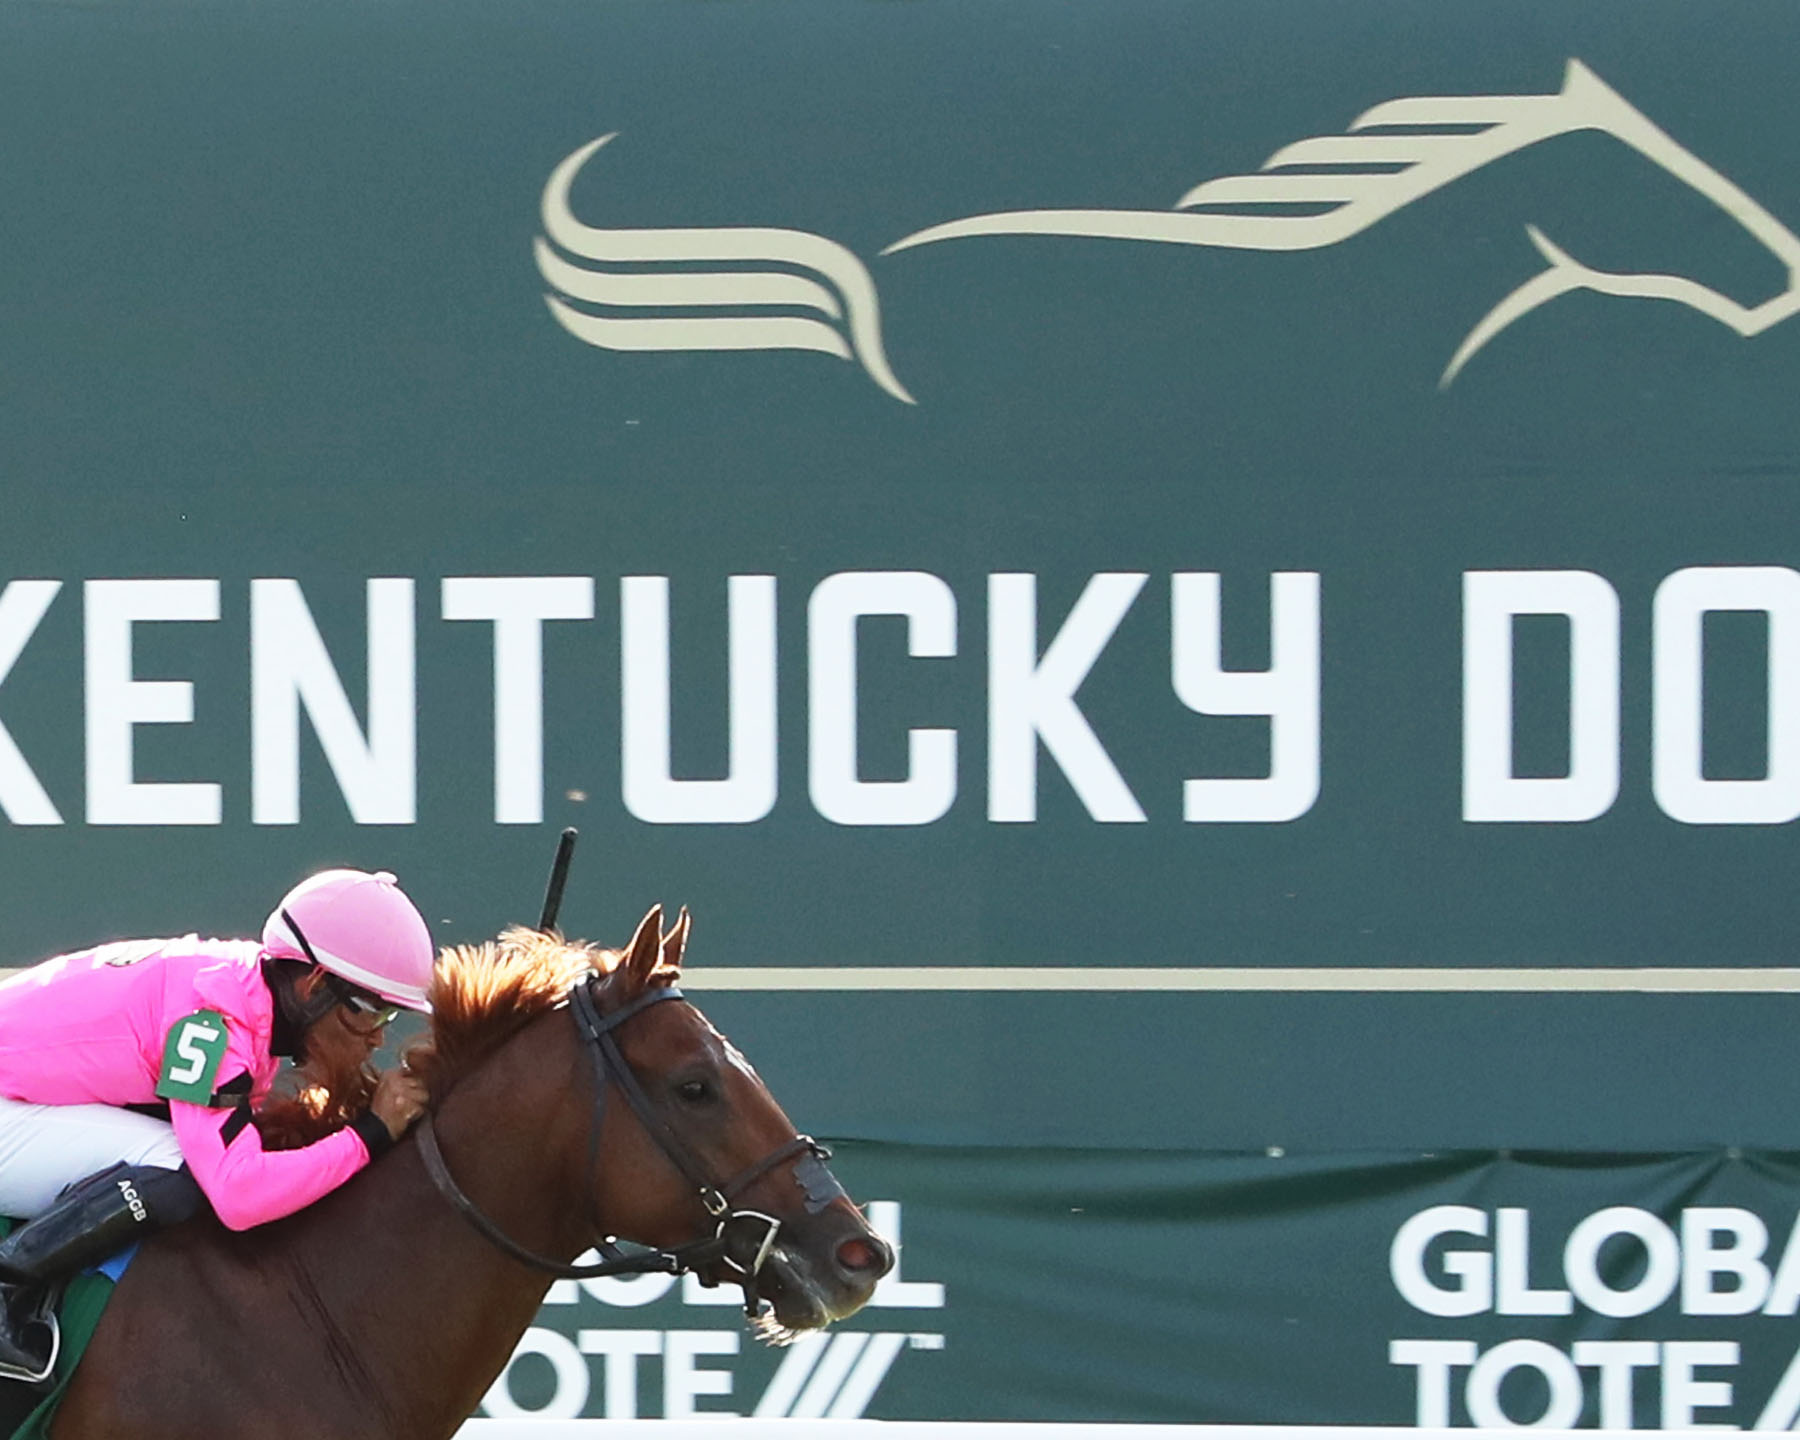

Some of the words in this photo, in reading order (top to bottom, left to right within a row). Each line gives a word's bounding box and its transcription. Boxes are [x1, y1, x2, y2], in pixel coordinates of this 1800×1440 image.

[169, 1021, 220, 1085] 5
[117, 1180, 147, 1222] AGGB
[481, 1326, 741, 1418] OTE
[1389, 1339, 1742, 1431] TOTE
